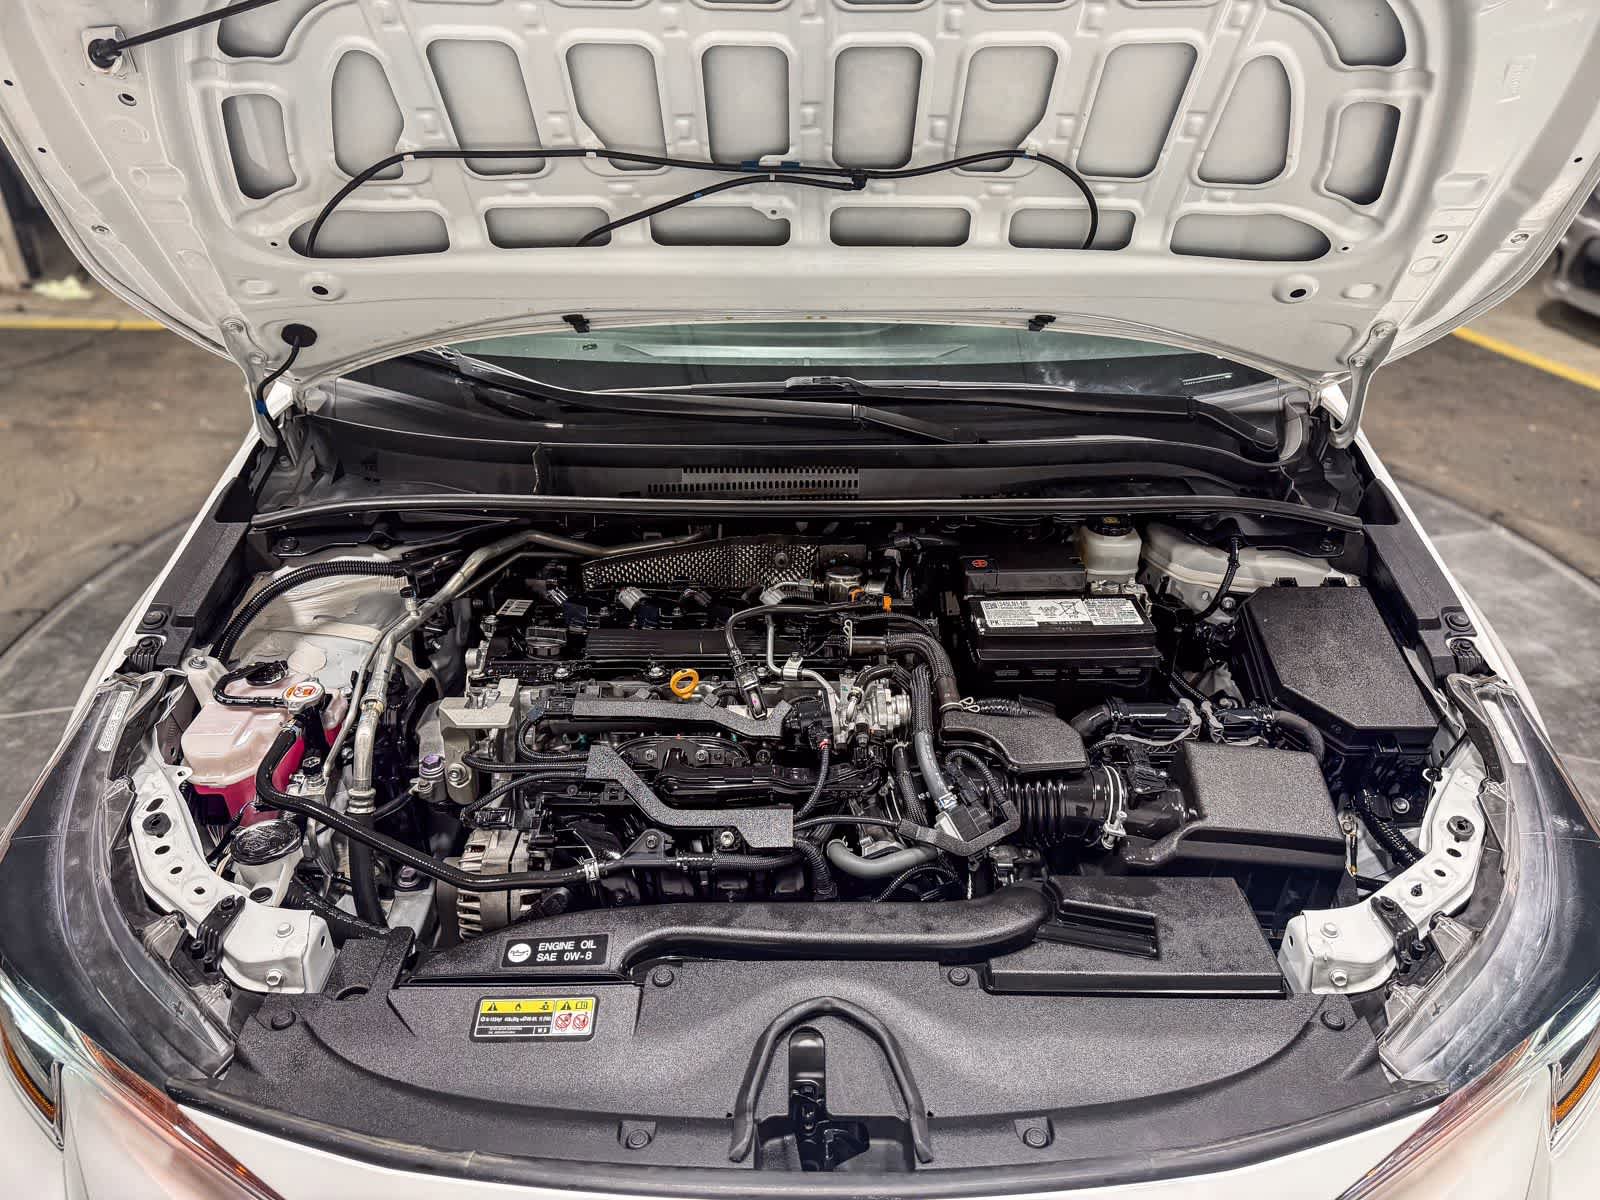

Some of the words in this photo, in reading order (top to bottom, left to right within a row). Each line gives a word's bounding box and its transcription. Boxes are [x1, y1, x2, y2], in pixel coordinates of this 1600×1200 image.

[538, 941, 575, 951] ENGINE
[580, 940, 597, 949] OIL
[536, 952, 558, 962] SAE
[563, 951, 593, 961] 0W-8
